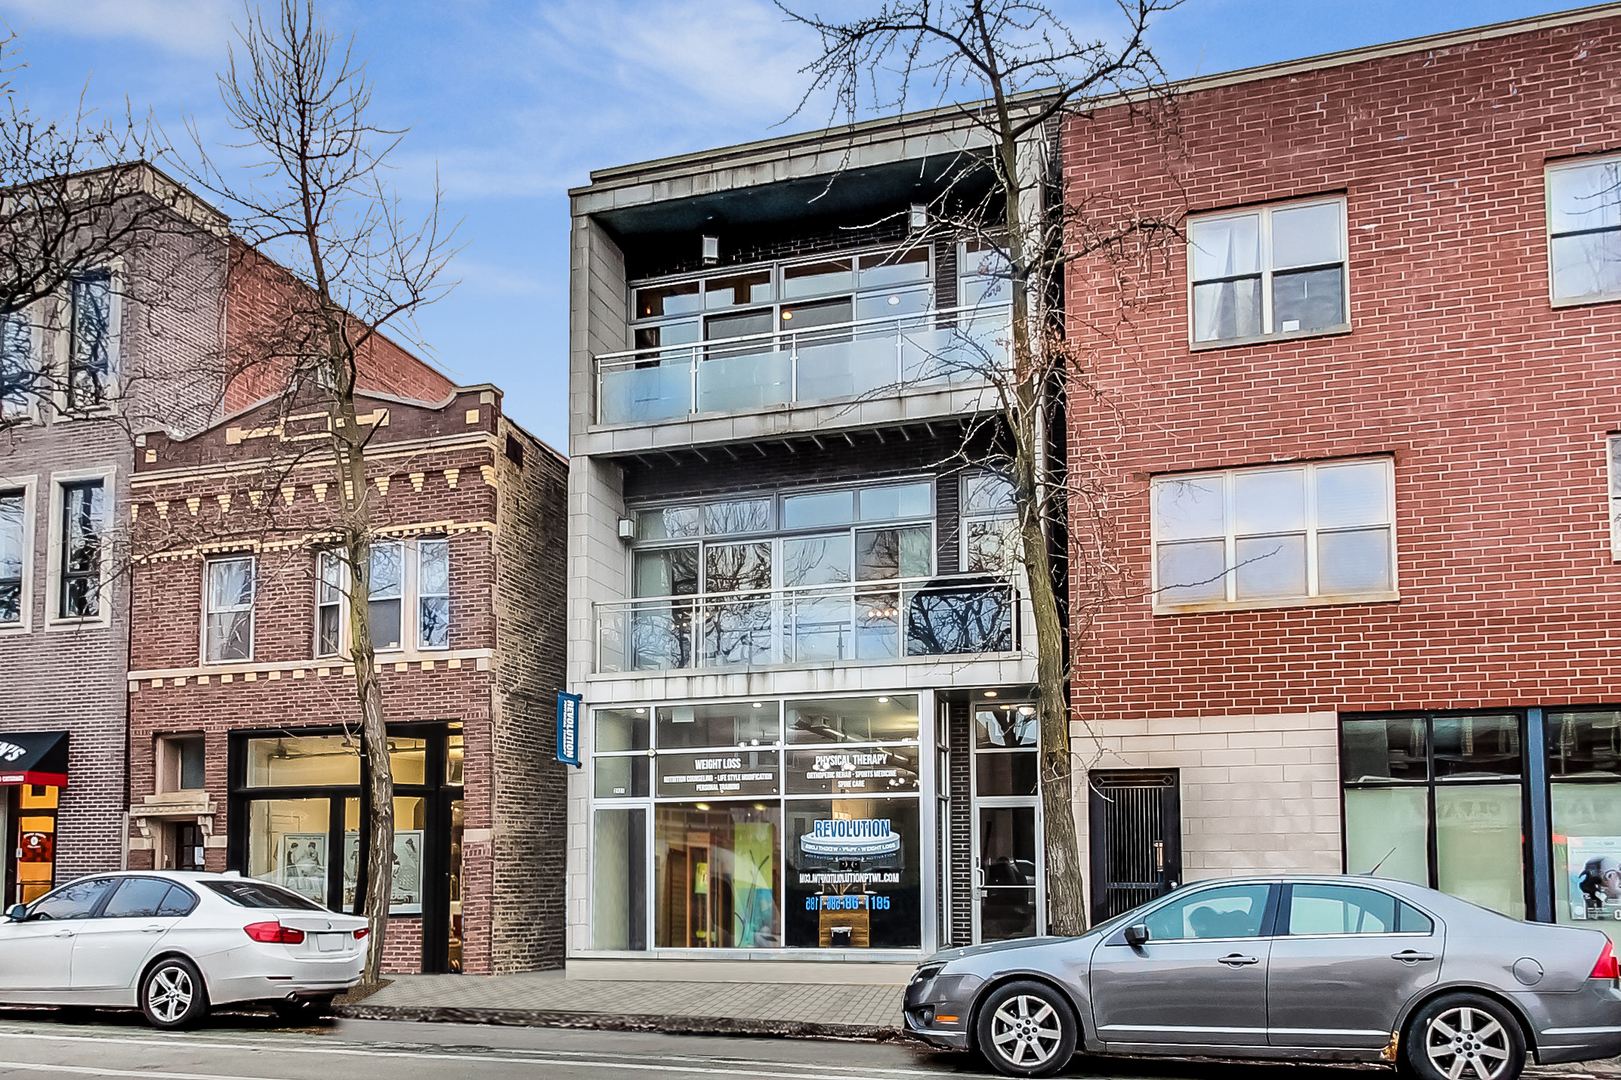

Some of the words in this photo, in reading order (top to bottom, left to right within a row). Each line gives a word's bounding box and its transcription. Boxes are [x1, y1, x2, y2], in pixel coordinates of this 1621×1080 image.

[567, 699, 575, 758] REVOLUTION
[0, 741, 26, 761] N'S
[695, 758, 722, 770] WEIGHT
[723, 757, 742, 769] LOSS
[815, 755, 850, 765] PHYSICAL
[853, 754, 888, 765] THERAPY
[855, 770, 873, 778] SPORTS
[837, 780, 852, 788] SPINE
[852, 779, 865, 788] CARE
[815, 820, 890, 838] REVOLUTION
